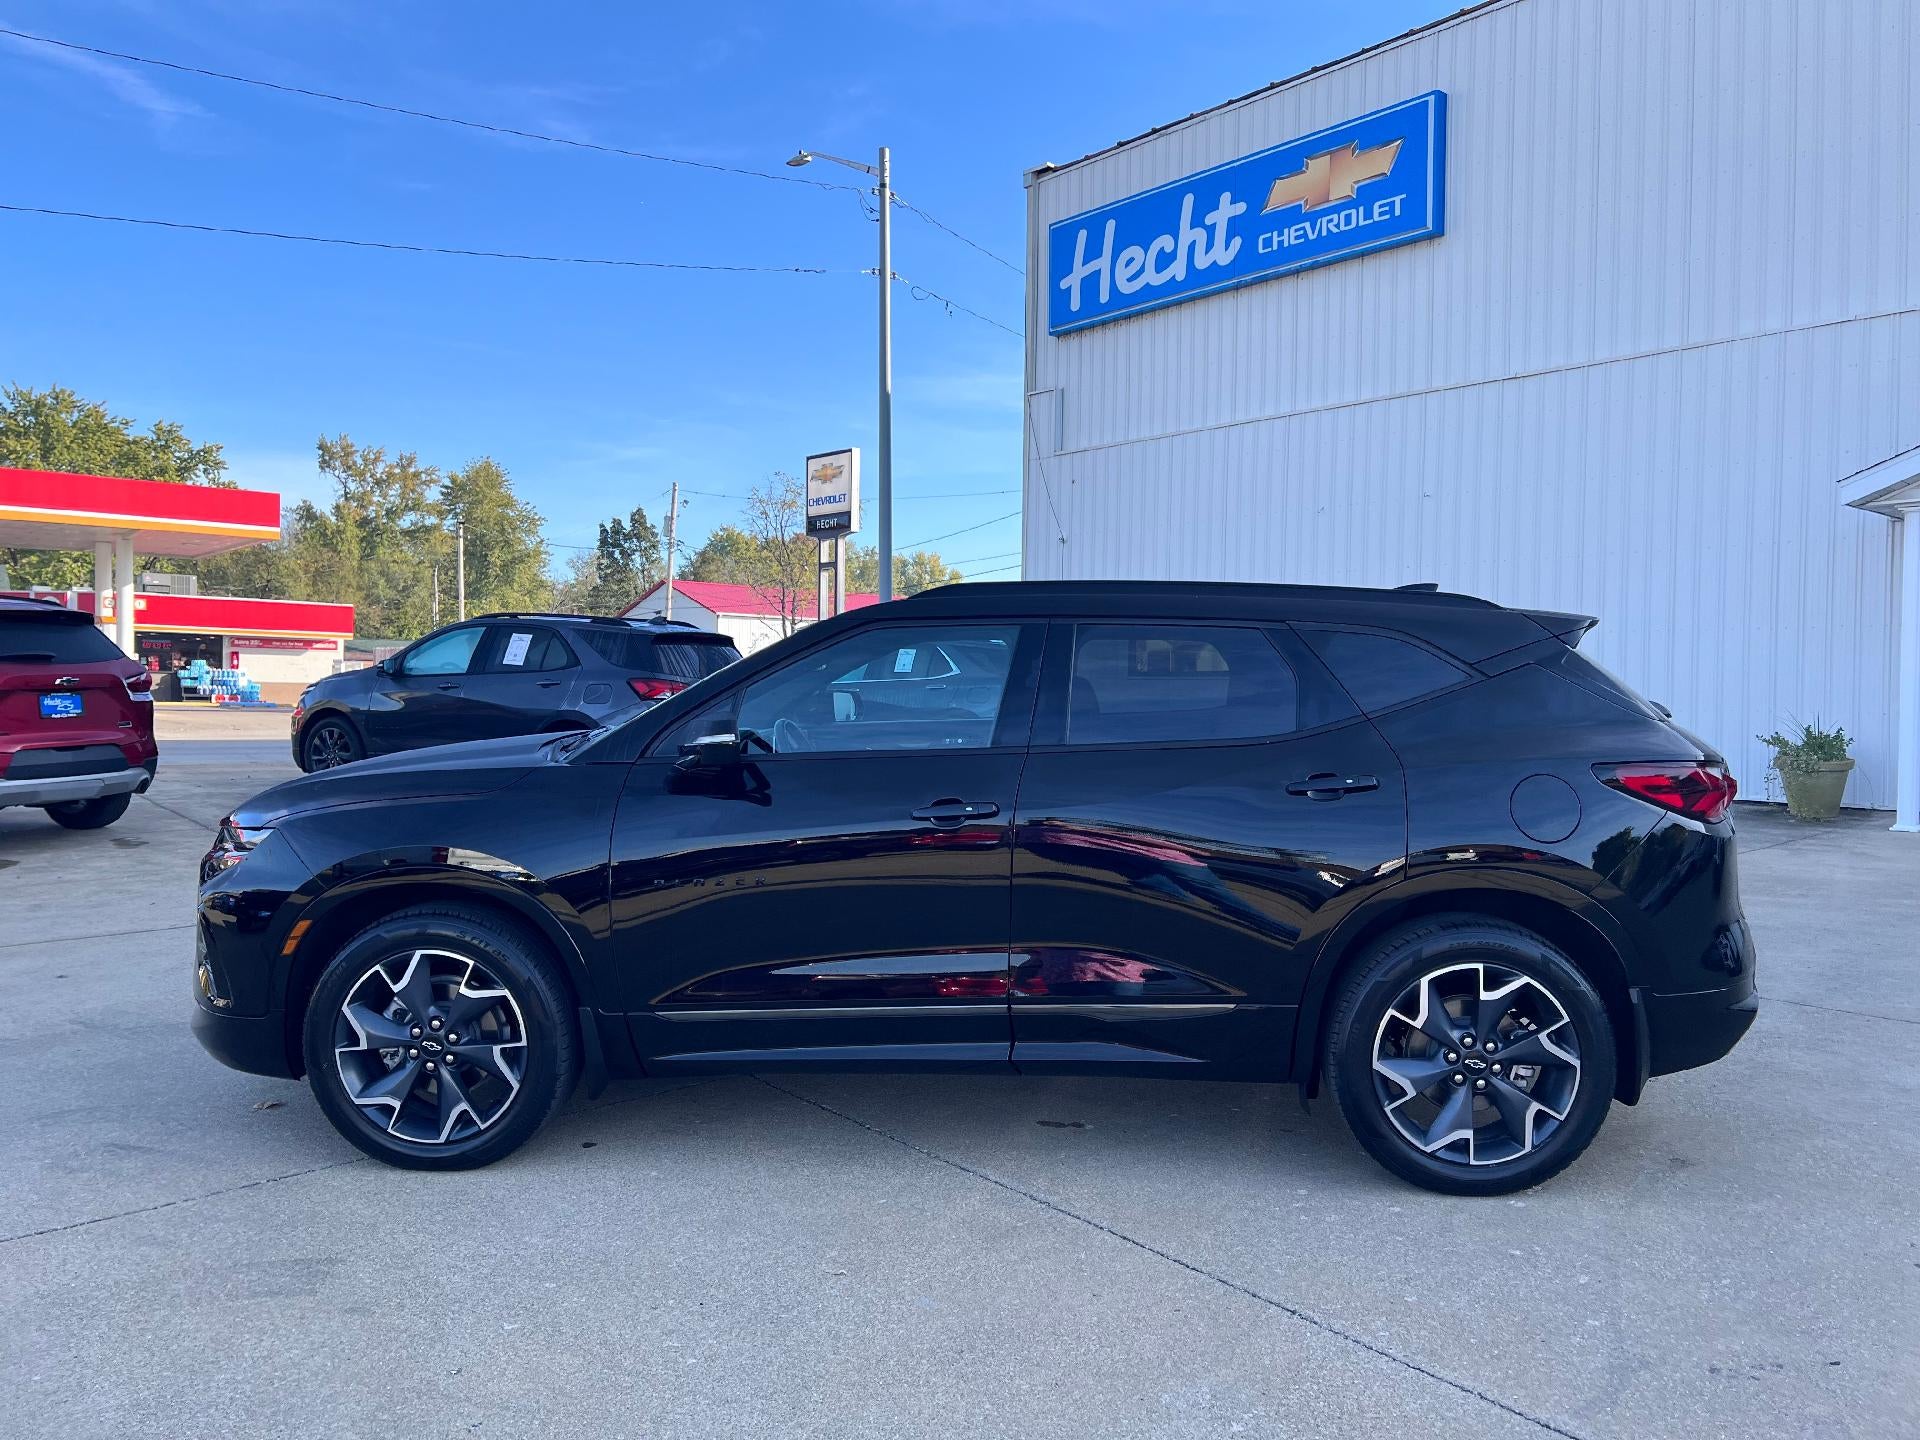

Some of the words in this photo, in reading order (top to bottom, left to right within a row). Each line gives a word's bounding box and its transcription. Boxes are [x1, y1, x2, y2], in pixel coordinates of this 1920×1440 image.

[1059, 191, 1247, 312] Hecht
[1258, 194, 1407, 254] CHEVROLET
[808, 493, 847, 507] CHEVROLET
